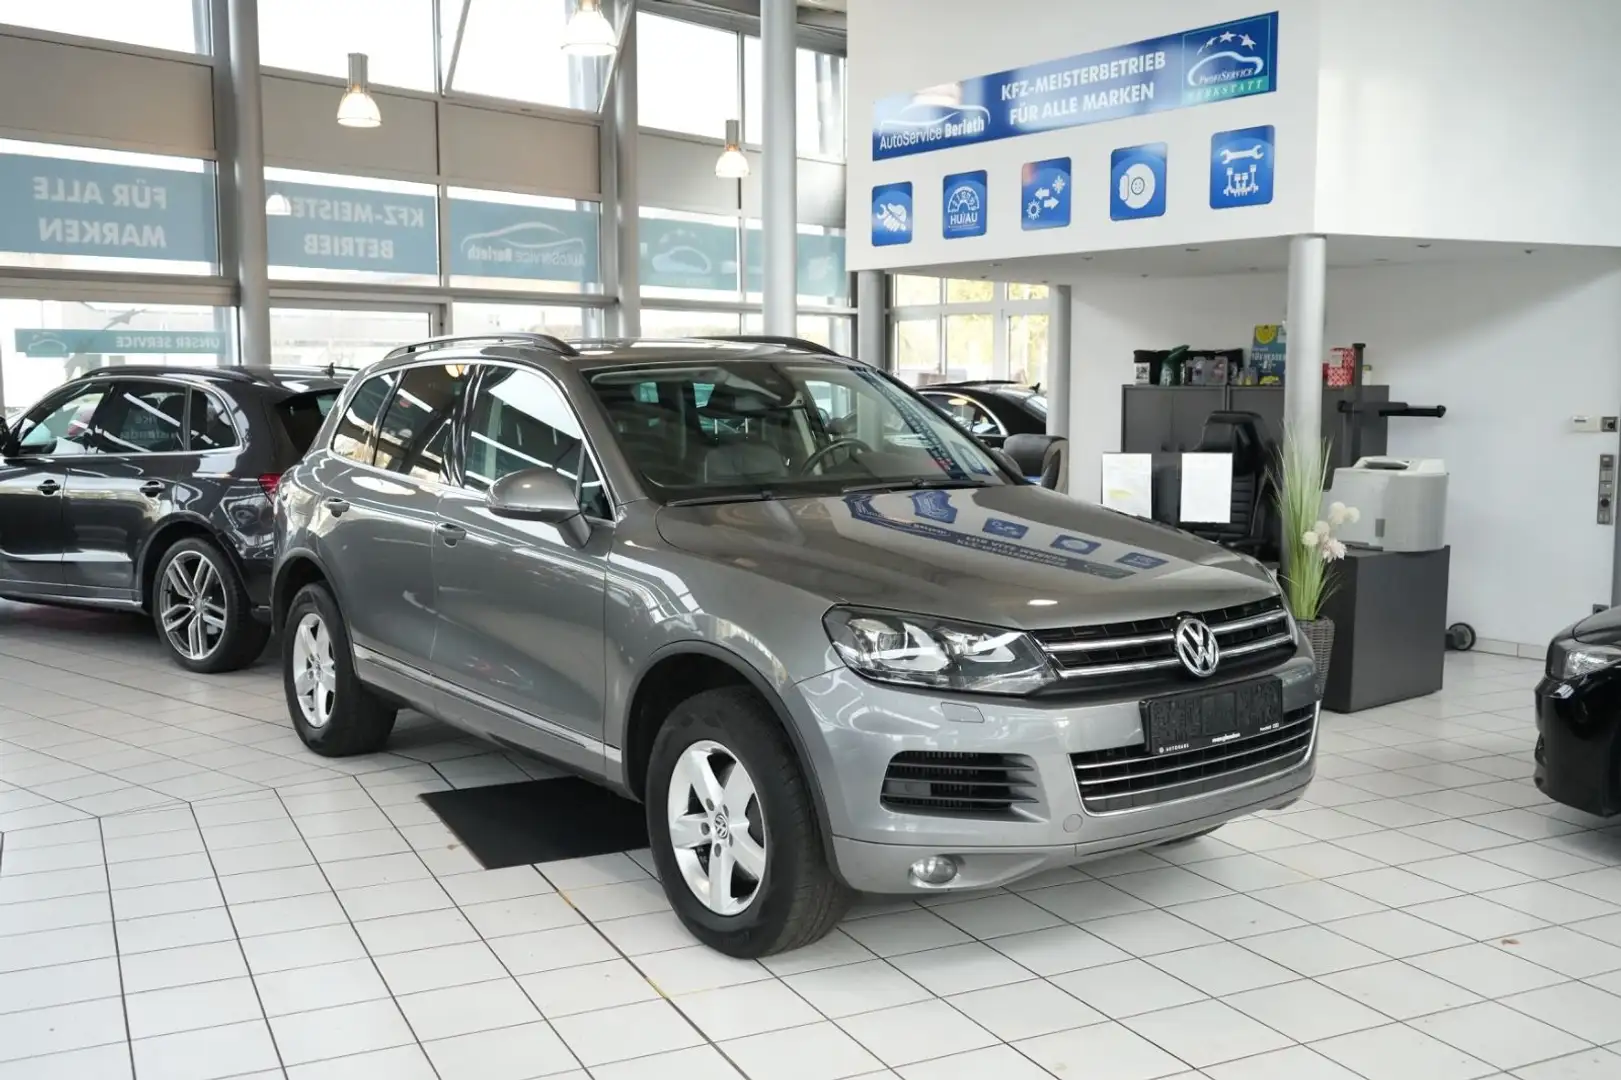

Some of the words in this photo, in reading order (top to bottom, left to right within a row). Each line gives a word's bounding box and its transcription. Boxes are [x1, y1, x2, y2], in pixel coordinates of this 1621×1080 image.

[1001, 52, 1167, 101] KFZ-MEISTERBETRIEB
[1185, 79, 1263, 101] ERKSTATT
[1010, 103, 1039, 125] FÜR
[1042, 97, 1078, 118] ALLE
[1083, 82, 1155, 111] MARKEN
[880, 127, 942, 151] AutoService
